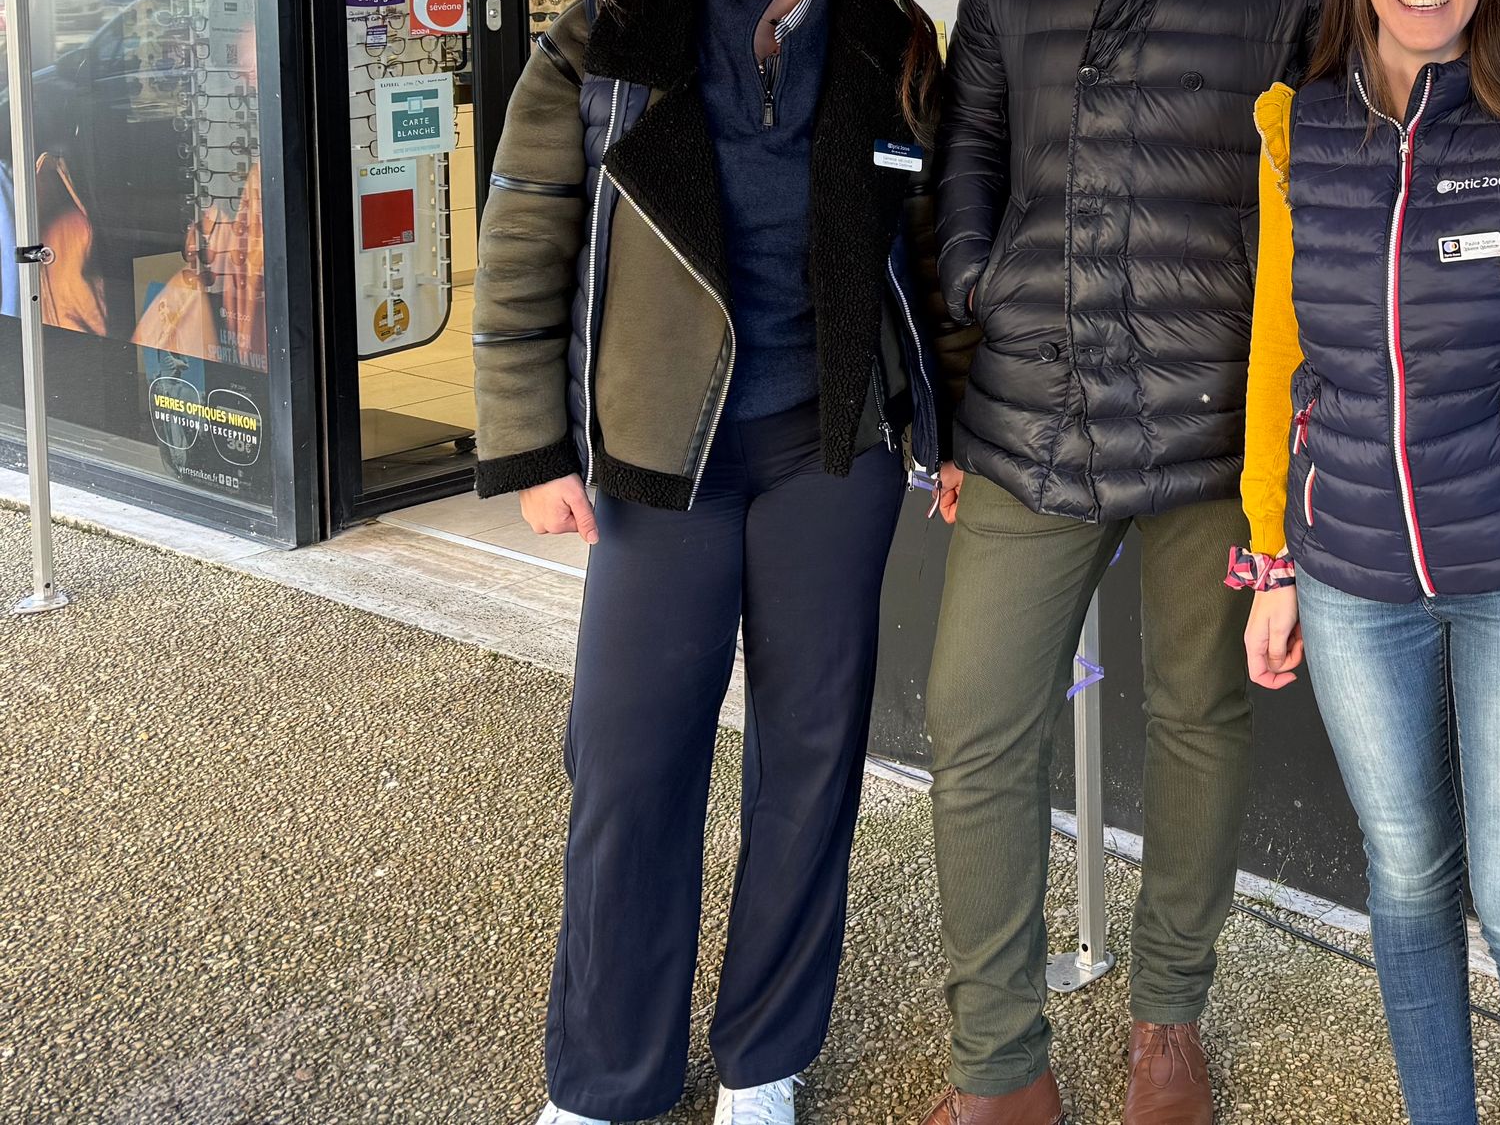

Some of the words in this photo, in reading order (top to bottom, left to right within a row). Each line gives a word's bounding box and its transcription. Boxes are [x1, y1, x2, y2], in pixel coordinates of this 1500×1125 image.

[429, 4, 462, 12] sévéane
[402, 117, 430, 126] CARTE
[397, 127, 436, 138] BLANCHE
[370, 165, 406, 176] Cadhoc
[1437, 178, 1480, 194] Optic
[154, 394, 184, 412] VERRES
[186, 402, 226, 423] OPTIQUES
[228, 413, 257, 431] NIKON
[155, 411, 170, 422] UNE
[173, 415, 199, 430] VISION
[204, 424, 257, 445] D'EXCEPTION
